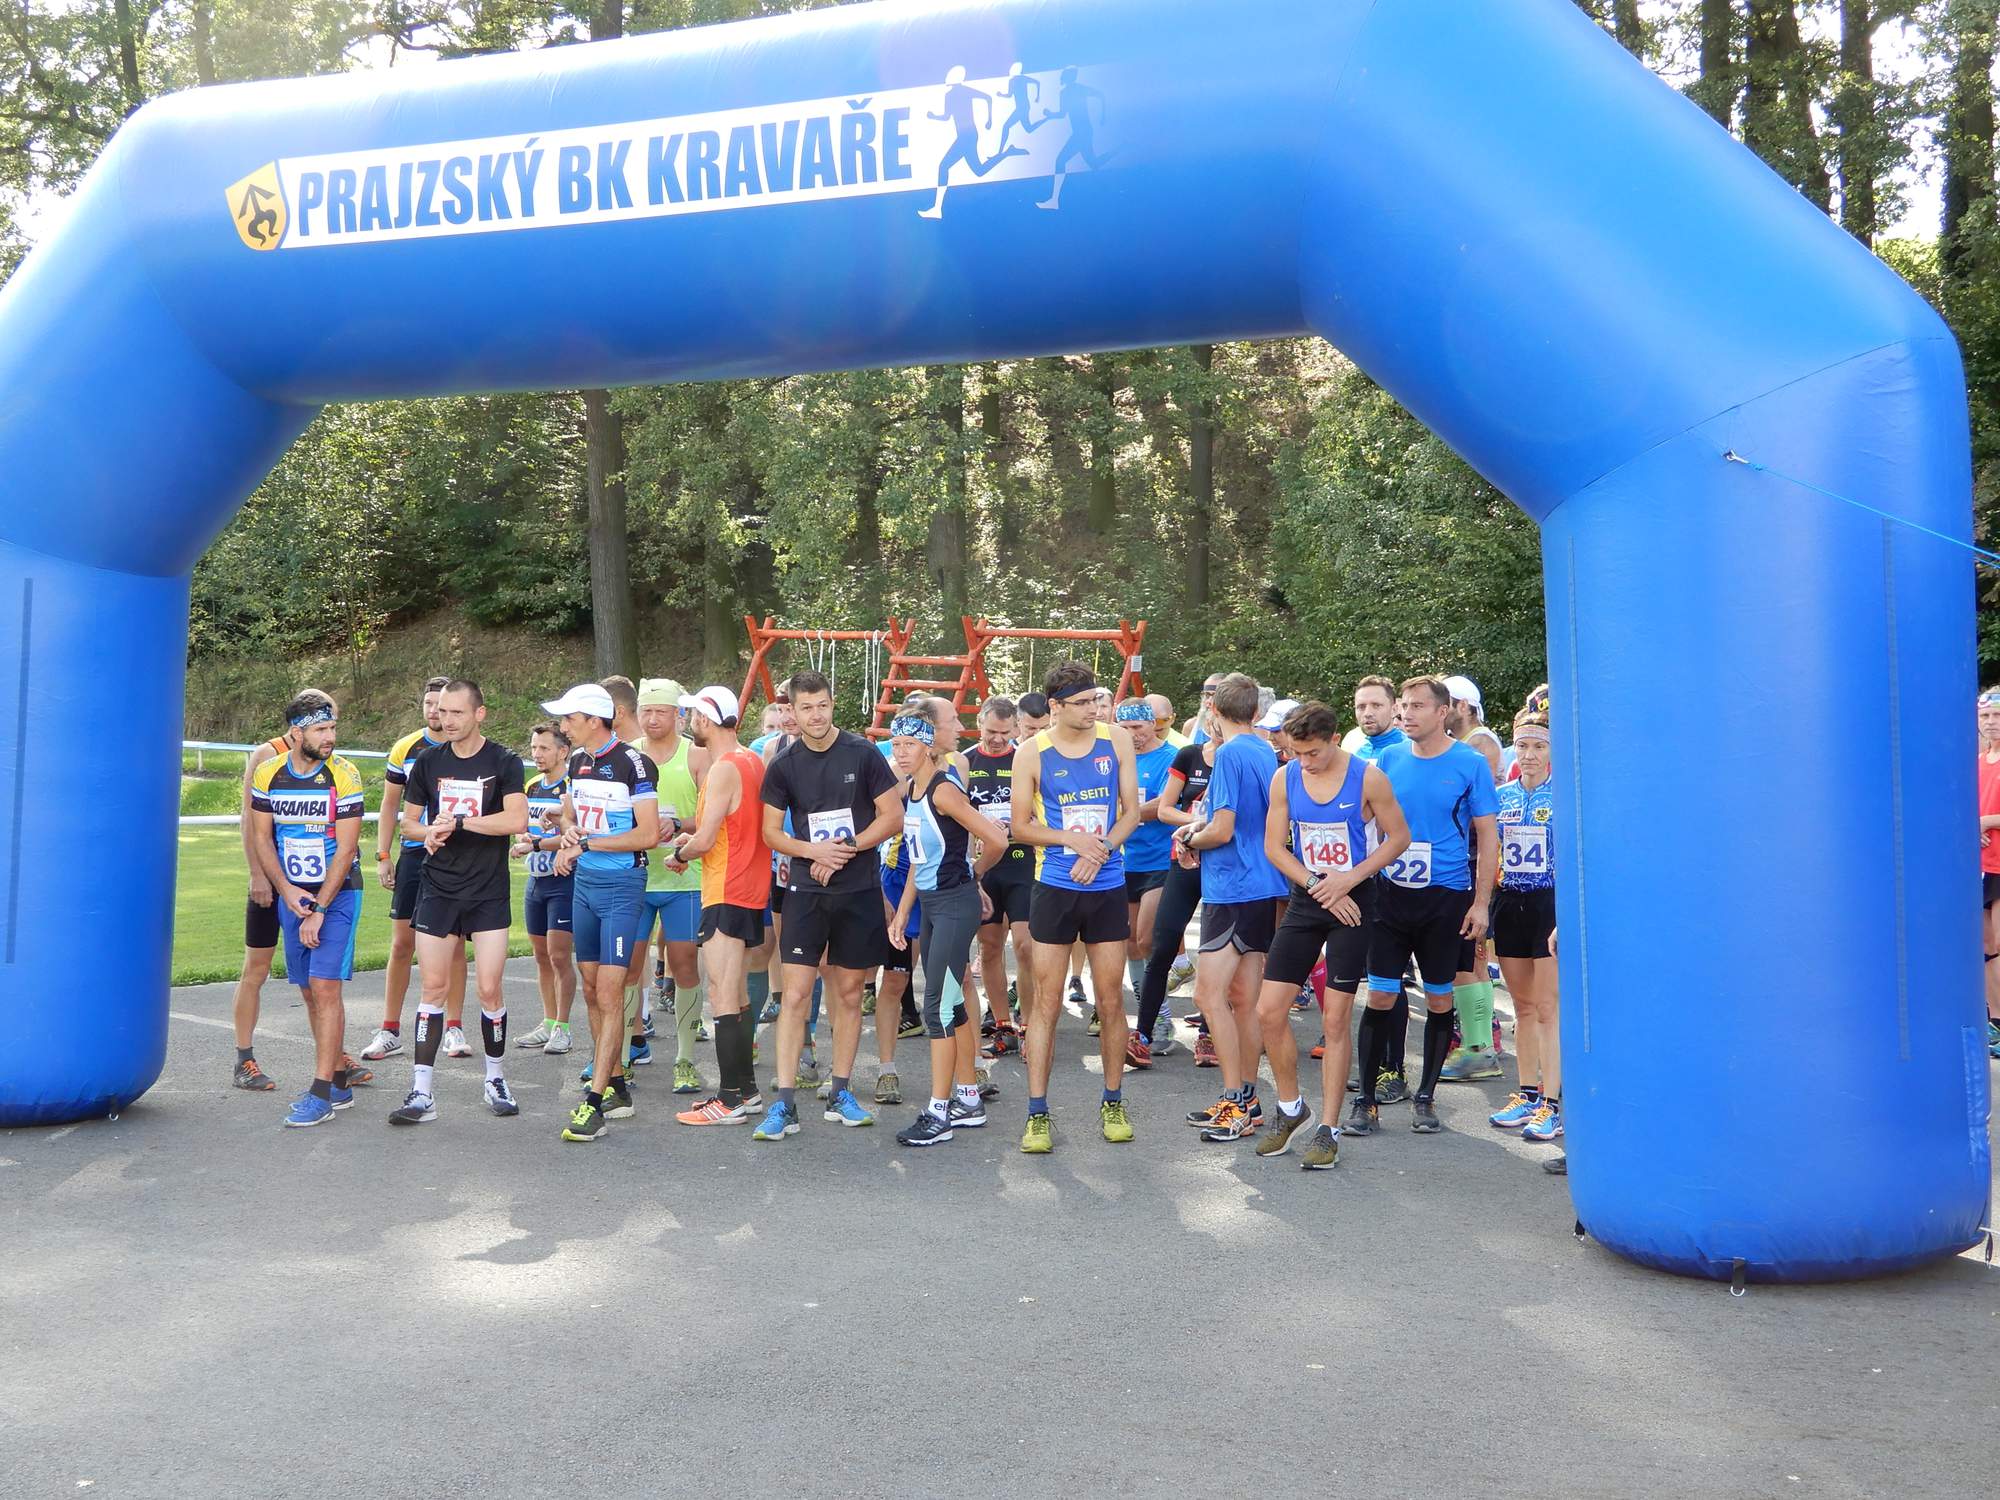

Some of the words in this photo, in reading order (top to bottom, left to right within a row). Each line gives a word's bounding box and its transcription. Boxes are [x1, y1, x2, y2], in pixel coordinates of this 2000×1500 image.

[299, 137, 545, 237] PRAJZSKÝ
[558, 139, 634, 214] BK
[647, 97, 912, 206] KRAVAŘE
[442, 796, 479, 817] 73
[1058, 792, 1077, 805] MK
[304, 824, 325, 832] TEAM
[578, 805, 604, 829] 77
[904, 833, 919, 858] 1
[1305, 842, 1349, 865] 148
[1506, 842, 1544, 867] 34
[287, 854, 323, 877] 63
[1389, 859, 1428, 882] 22
